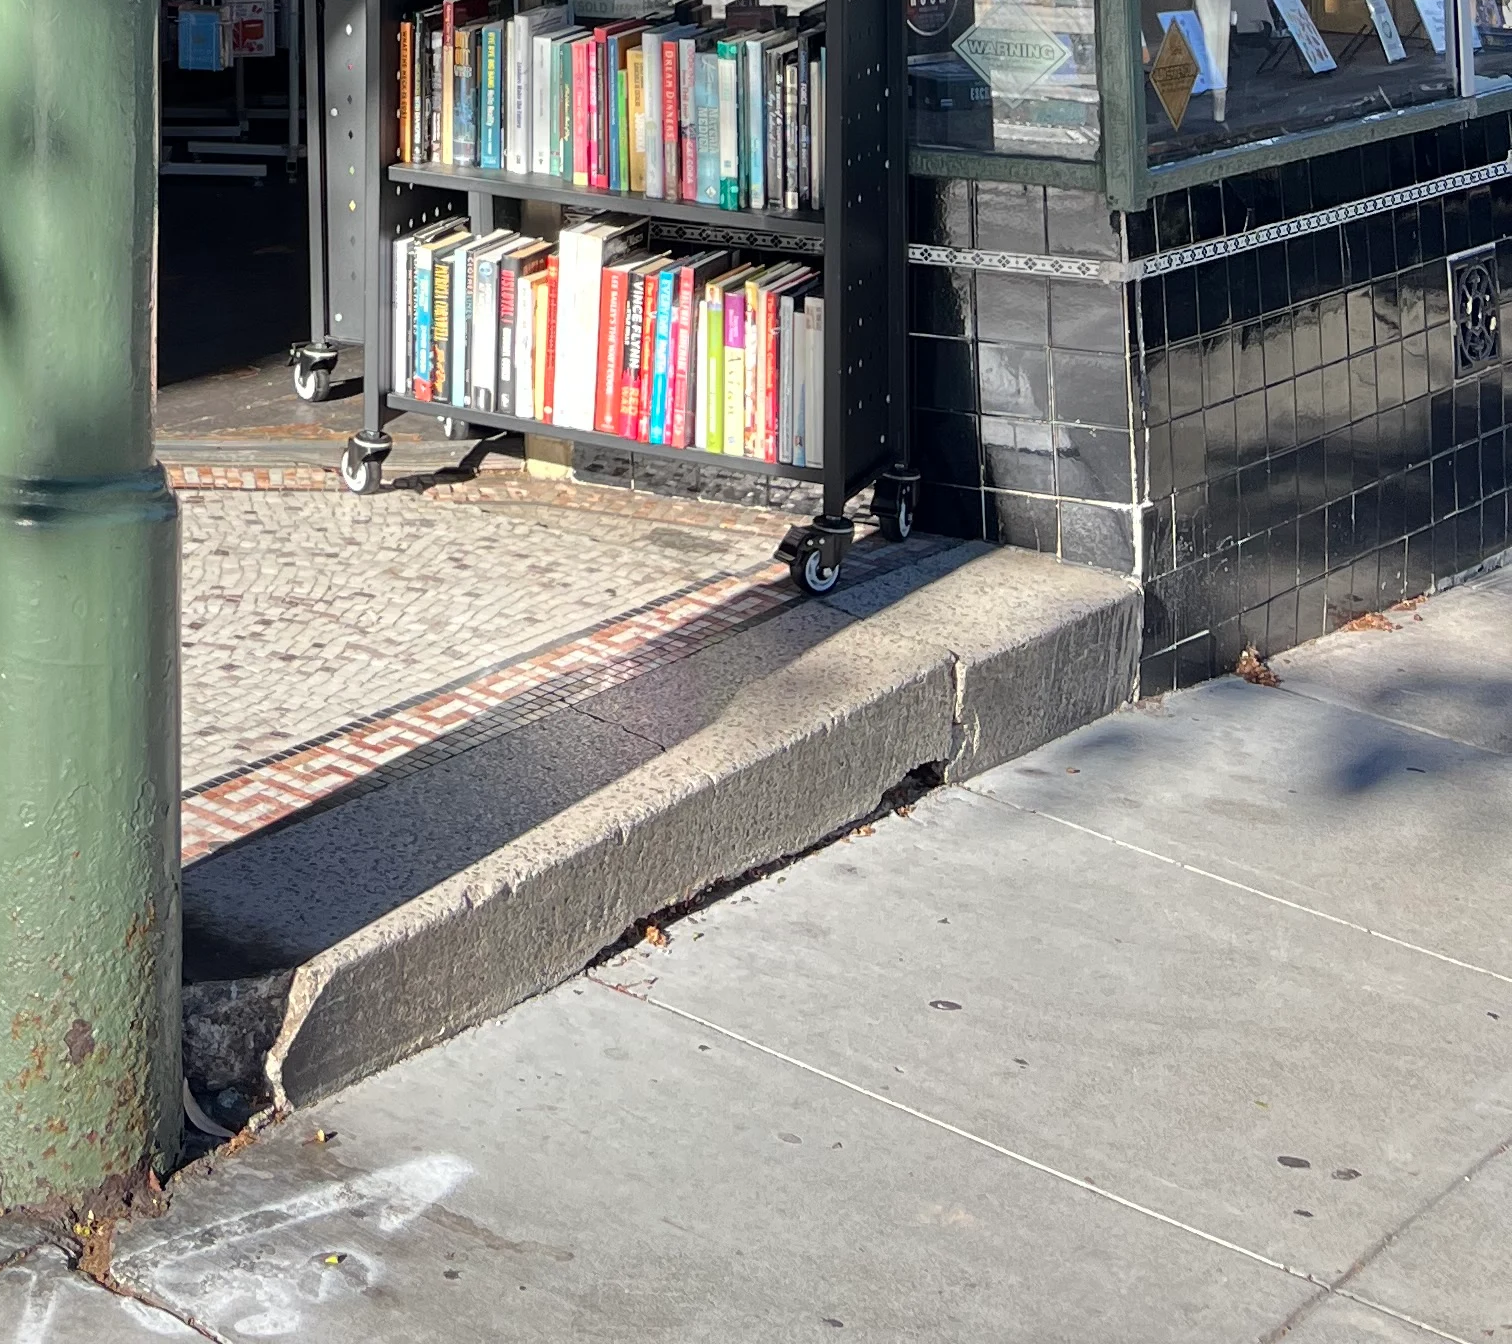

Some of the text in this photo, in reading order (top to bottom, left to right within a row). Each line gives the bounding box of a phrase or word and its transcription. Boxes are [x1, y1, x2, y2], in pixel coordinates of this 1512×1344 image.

[576, 0, 608, 13] SOLD
[966, 37, 1056, 60] WARNING
[664, 50, 676, 138] DREAM DINNERS
[697, 106, 708, 154] MEDICA
[707, 106, 719, 154] MATERIA
[434, 263, 450, 299] PATRICIA
[610, 275, 618, 289] LEE
[433, 300, 449, 342] CORNWELL
[608, 325, 617, 343] THE
[629, 281, 644, 369] VINCE FLYNN
[619, 386, 630, 415] WAR
[629, 386, 640, 416] RED
